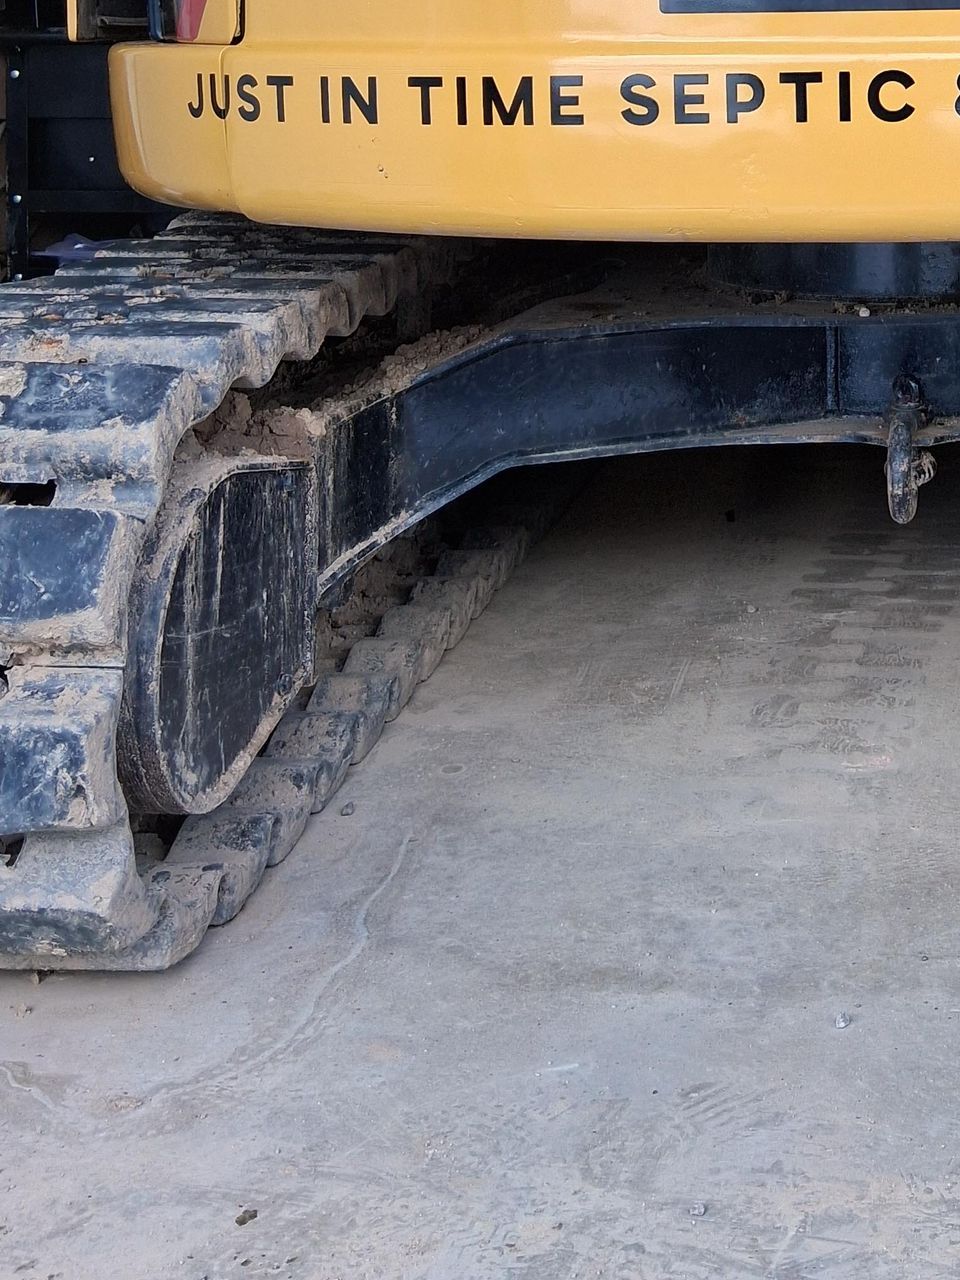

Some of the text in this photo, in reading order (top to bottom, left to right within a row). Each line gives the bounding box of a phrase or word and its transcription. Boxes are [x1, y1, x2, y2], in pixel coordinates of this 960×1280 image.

[187, 73, 294, 123] JUST
[320, 75, 379, 125] IN
[407, 75, 584, 126] TIME
[620, 70, 916, 126] SEPTIC
